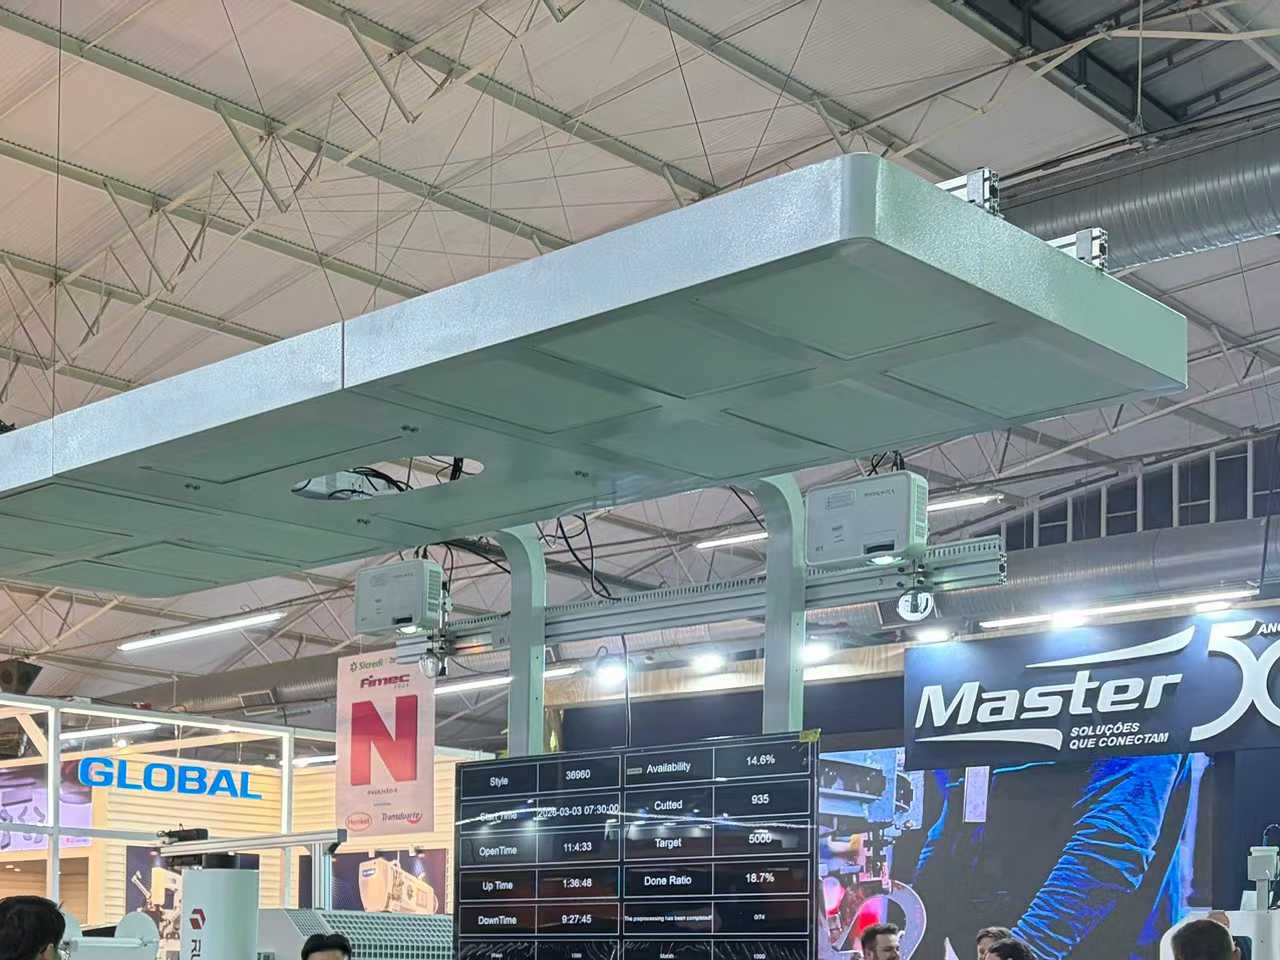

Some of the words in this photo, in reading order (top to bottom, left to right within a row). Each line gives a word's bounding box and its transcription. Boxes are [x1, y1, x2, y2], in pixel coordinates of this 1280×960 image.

[360, 674, 410, 688] Fimec
[914, 670, 1183, 728] Master
[1070, 722, 1140, 737] SOLUÇÕES
[351, 694, 418, 786] N
[1070, 738, 1095, 750] QUE
[1098, 732, 1169, 748] CONECTAM
[746, 755, 776, 766] 14.6%
[646, 762, 691, 774] Availability
[79, 756, 263, 800] GLOBAL
[489, 776, 508, 788] Style
[751, 794, 769, 805] 935
[654, 800, 683, 811] Cutted
[654, 838, 682, 849] Target
[748, 833, 772, 844] 5000
[563, 842, 592, 852] 11:4:33
[644, 876, 667, 886] Done
[669, 875, 692, 885] Ratio
[745, 872, 775, 883] 18.7%
[482, 882, 493, 892] Up
[495, 881, 513, 890] Time
[561, 914, 592, 924] 9:27:45
